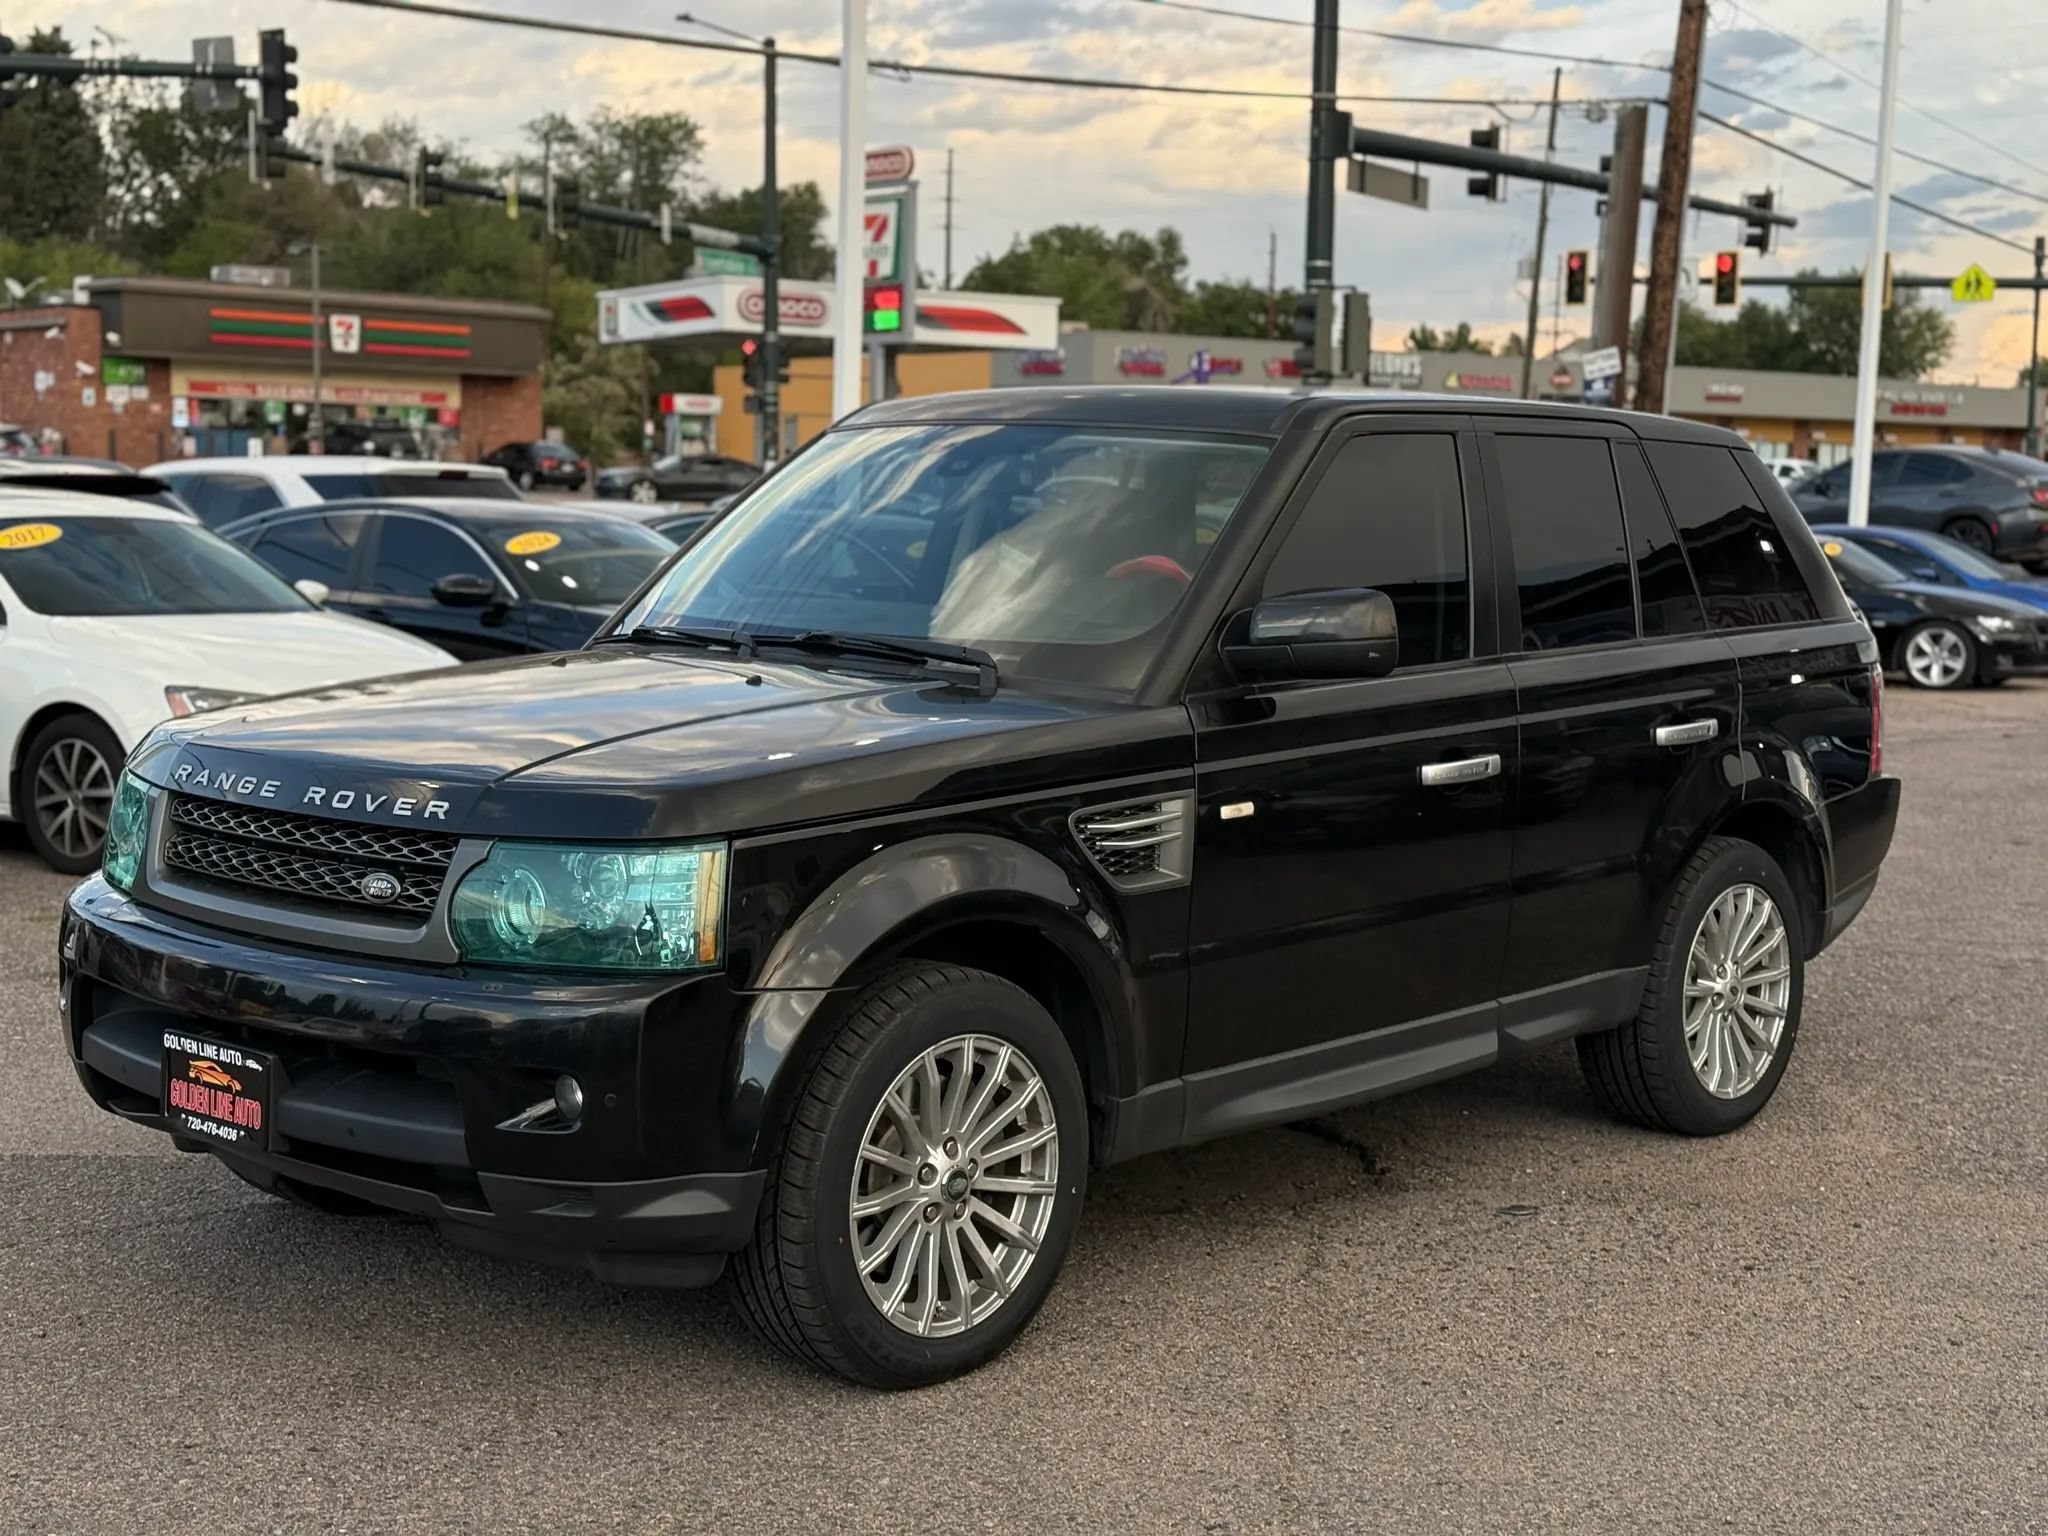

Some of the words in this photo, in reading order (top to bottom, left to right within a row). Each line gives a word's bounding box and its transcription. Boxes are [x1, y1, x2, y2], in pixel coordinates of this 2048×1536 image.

[3, 526, 46, 546] 2017
[175, 764, 281, 798] RANGE
[303, 786, 450, 820] ROVER
[368, 880, 388, 889] LAND
[369, 887, 392, 897] ROVER
[164, 1033, 198, 1055] GOLDEN
[199, 1042, 218, 1060] LINE
[219, 1047, 242, 1066] AUTO
[171, 1078, 209, 1115] GOLDEN
[210, 1089, 233, 1122] LINE
[234, 1096, 261, 1130] AUTO
[187, 1116, 237, 1141] 720-476-4036
